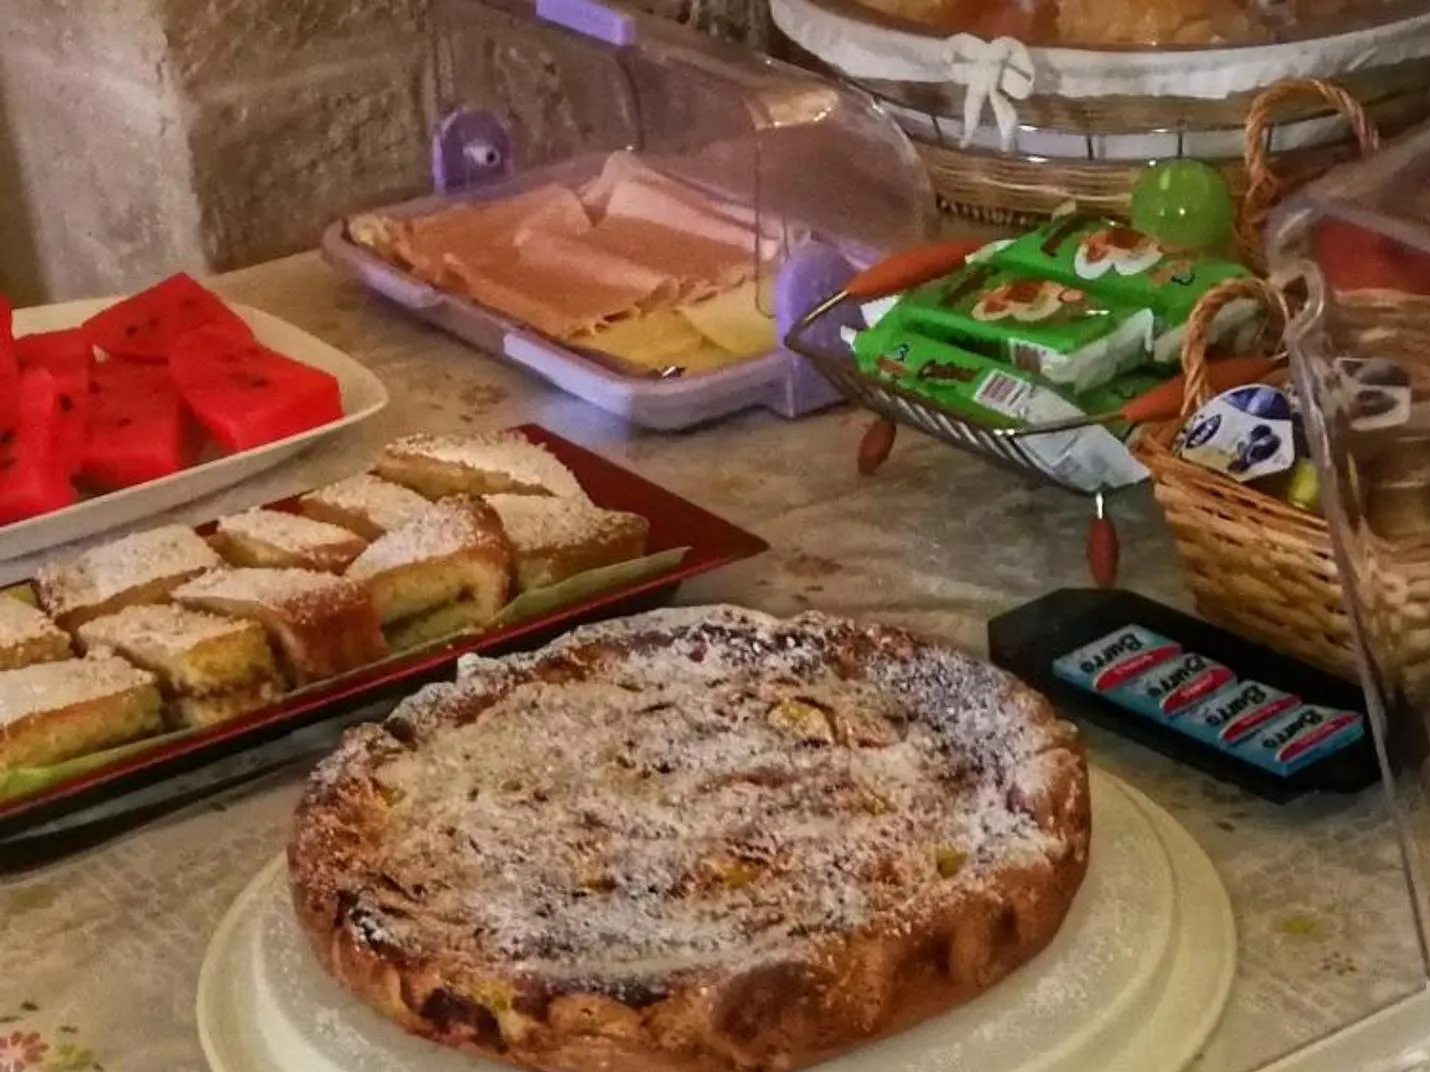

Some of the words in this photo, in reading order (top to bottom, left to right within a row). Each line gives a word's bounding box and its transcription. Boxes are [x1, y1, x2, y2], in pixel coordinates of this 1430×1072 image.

[1080, 632, 1143, 673] Burro
[1147, 654, 1208, 697] Burro
[1205, 684, 1267, 727] Burro
[1262, 708, 1323, 749] Burro
